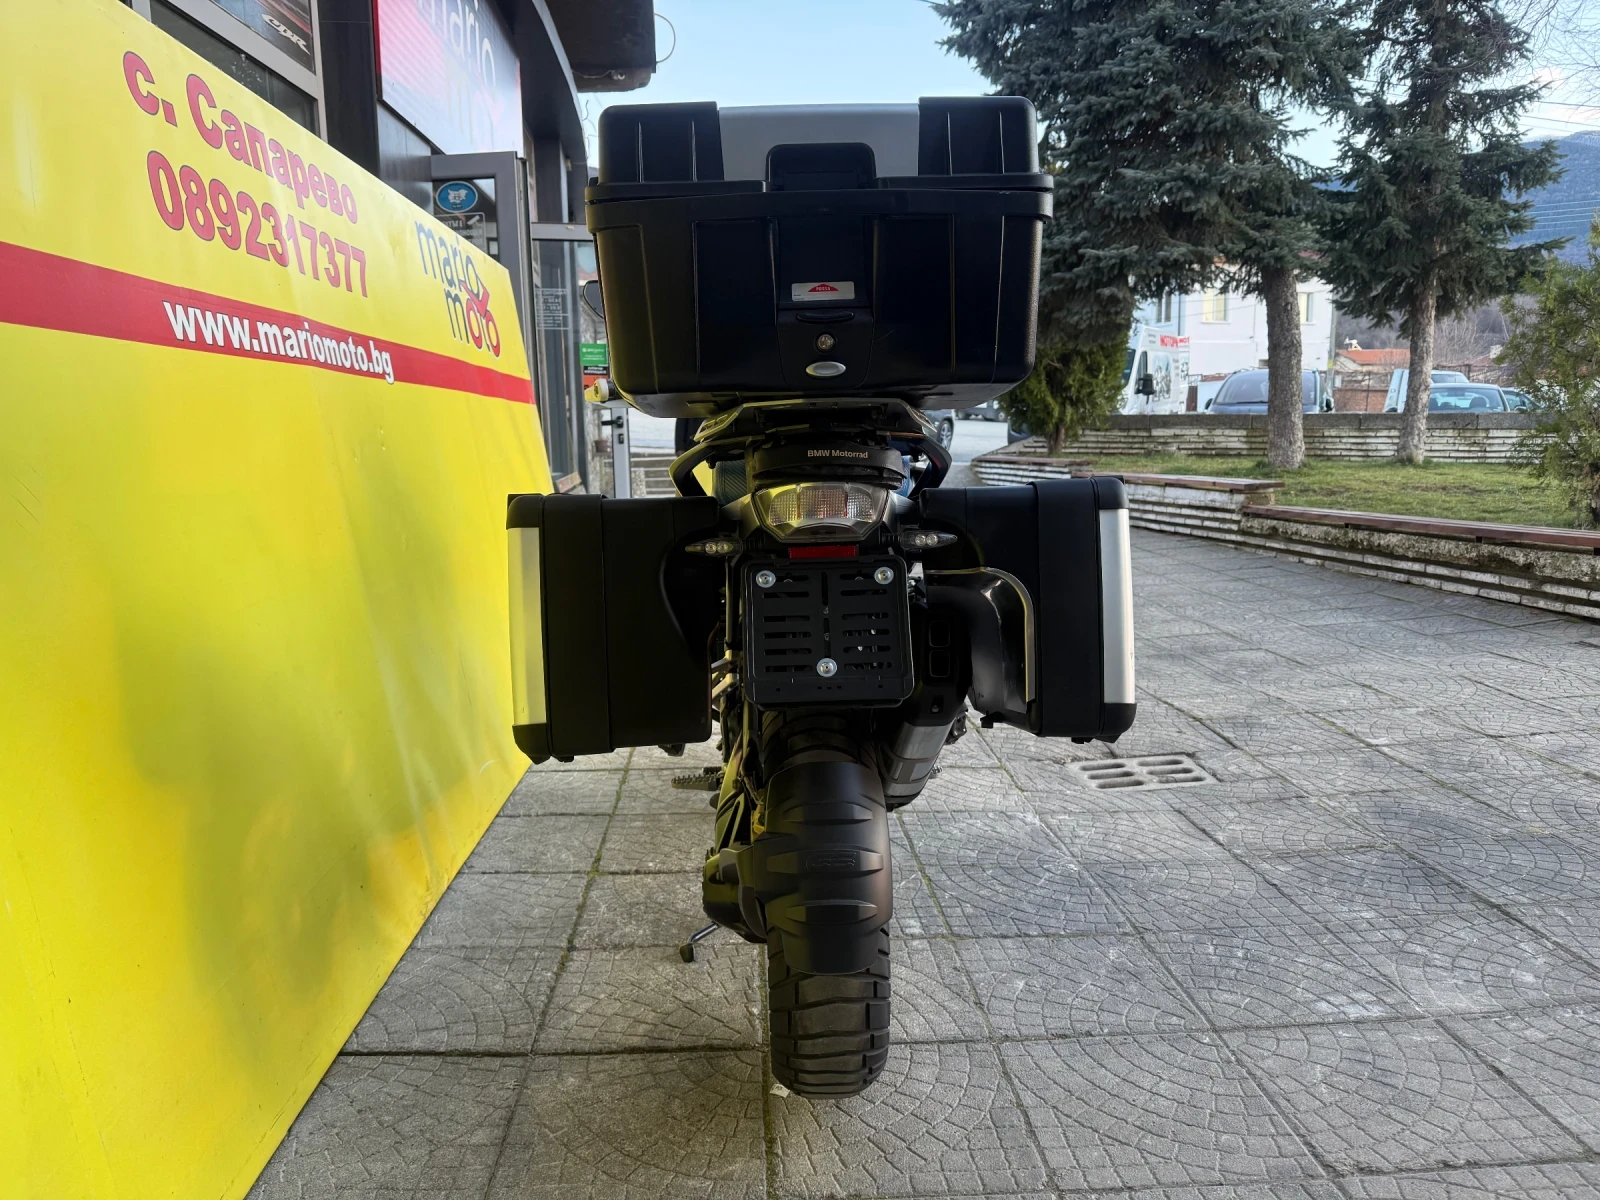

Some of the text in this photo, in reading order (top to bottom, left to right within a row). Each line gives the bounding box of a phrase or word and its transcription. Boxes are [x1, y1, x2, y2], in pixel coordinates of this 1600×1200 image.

[186, 73, 358, 224] Сапарево
[147, 150, 368, 298] 0892317377
[414, 220, 481, 301] mario
[163, 301, 394, 385] www.mariomoto.bg
[444, 287, 500, 358] moto
[807, 449, 868, 458] BMW Motorrad
